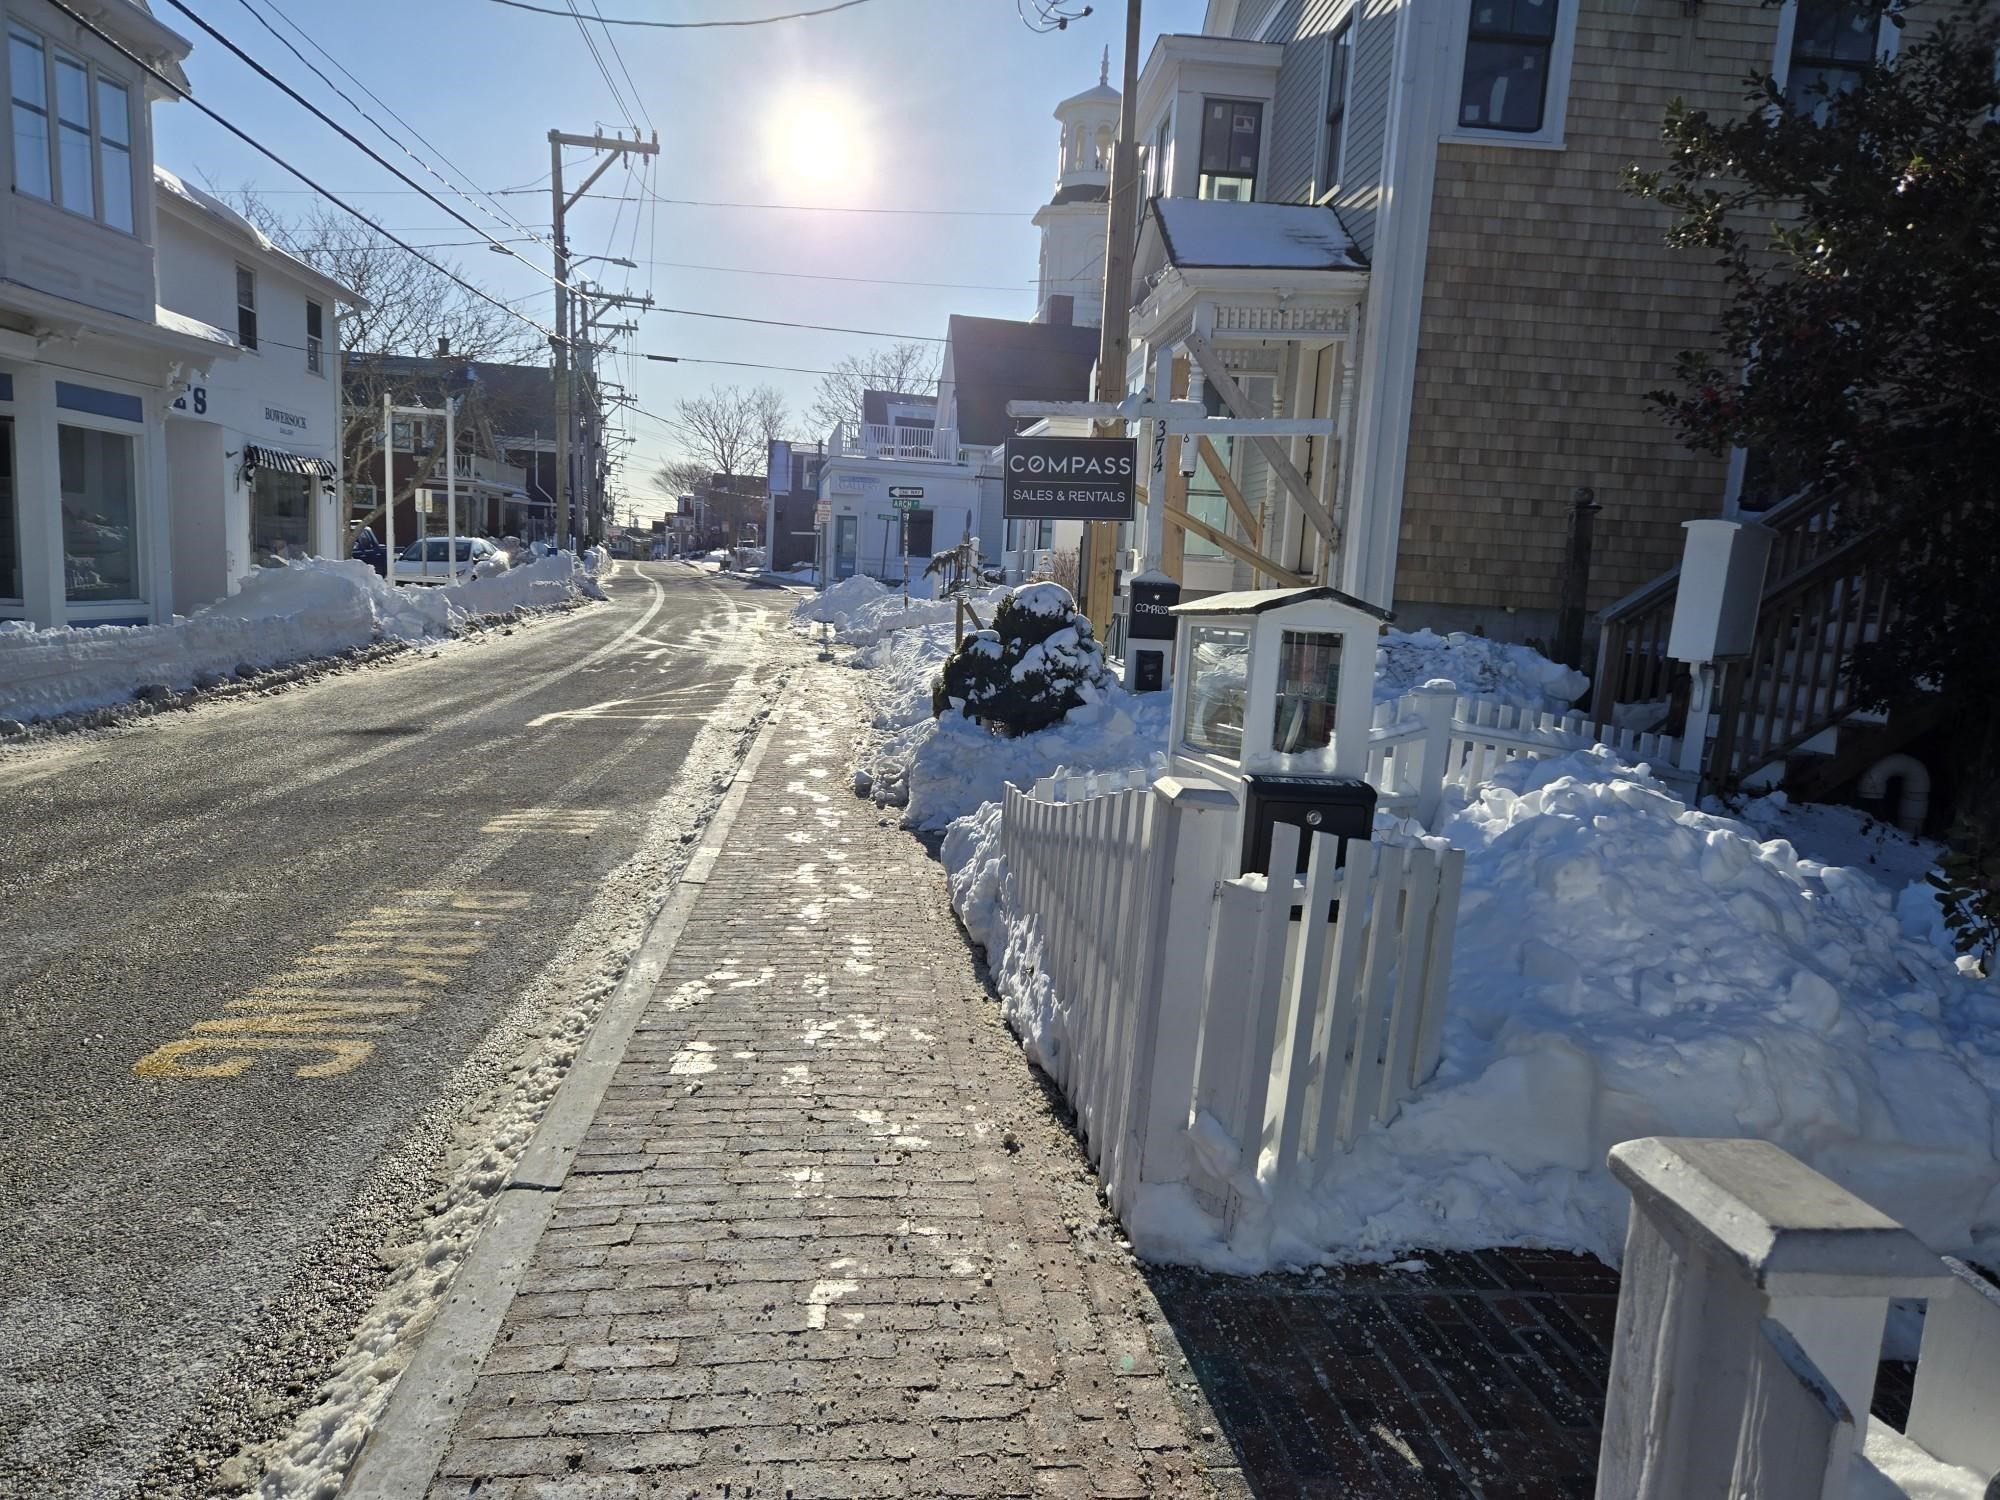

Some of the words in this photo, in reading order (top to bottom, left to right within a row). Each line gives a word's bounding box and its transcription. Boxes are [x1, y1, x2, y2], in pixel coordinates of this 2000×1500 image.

[265, 408, 307, 429] BOWERSOCK
[1154, 419, 1166, 472] 374
[1010, 455, 1131, 475] COMPASS
[893, 500, 912, 508] ARCH
[1013, 490, 1053, 501] SALES
[1056, 490, 1065, 501] &
[1068, 490, 1126, 502] RENTALS
[1135, 603, 1168, 614] COMPASS
[132, 888, 534, 1080] PARKING
